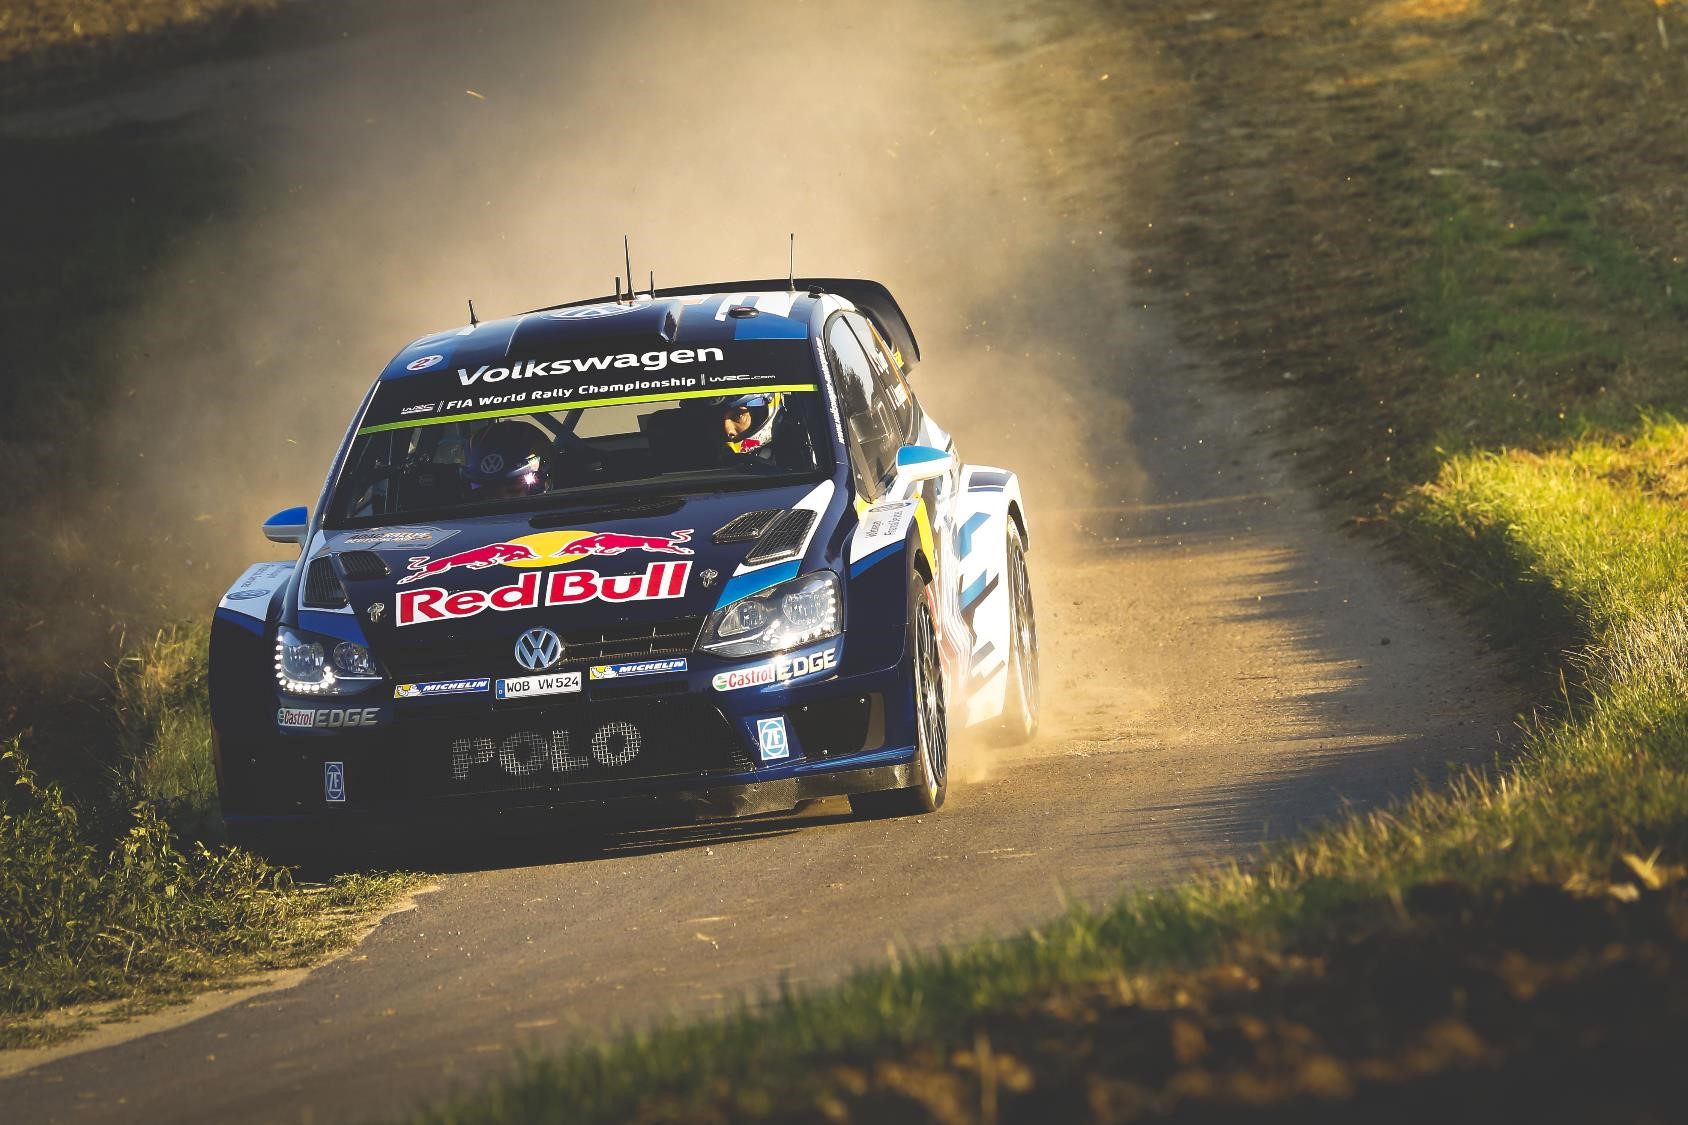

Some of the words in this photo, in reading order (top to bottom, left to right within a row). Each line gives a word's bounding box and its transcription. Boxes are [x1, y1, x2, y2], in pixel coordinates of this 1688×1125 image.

[457, 347, 724, 386] Volkswagen
[446, 399, 473, 410] FIA
[479, 392, 526, 405] World
[532, 388, 573, 400] Rally
[578, 377, 696, 394] Championship
[396, 571, 542, 627] Red
[546, 561, 693, 606] Bull
[618, 659, 684, 673] MICHELIN
[728, 664, 774, 688] Castrol
[776, 648, 838, 682] EDGE
[422, 680, 488, 692] MICHELIN
[507, 681, 530, 693] WOB
[538, 679, 554, 690] VW
[556, 676, 579, 688] 524
[284, 711, 313, 727] Castrol
[315, 707, 381, 727] EDGE
[764, 729, 783, 750] ZF
[452, 721, 643, 780] POLO
[328, 771, 342, 791] ZF
